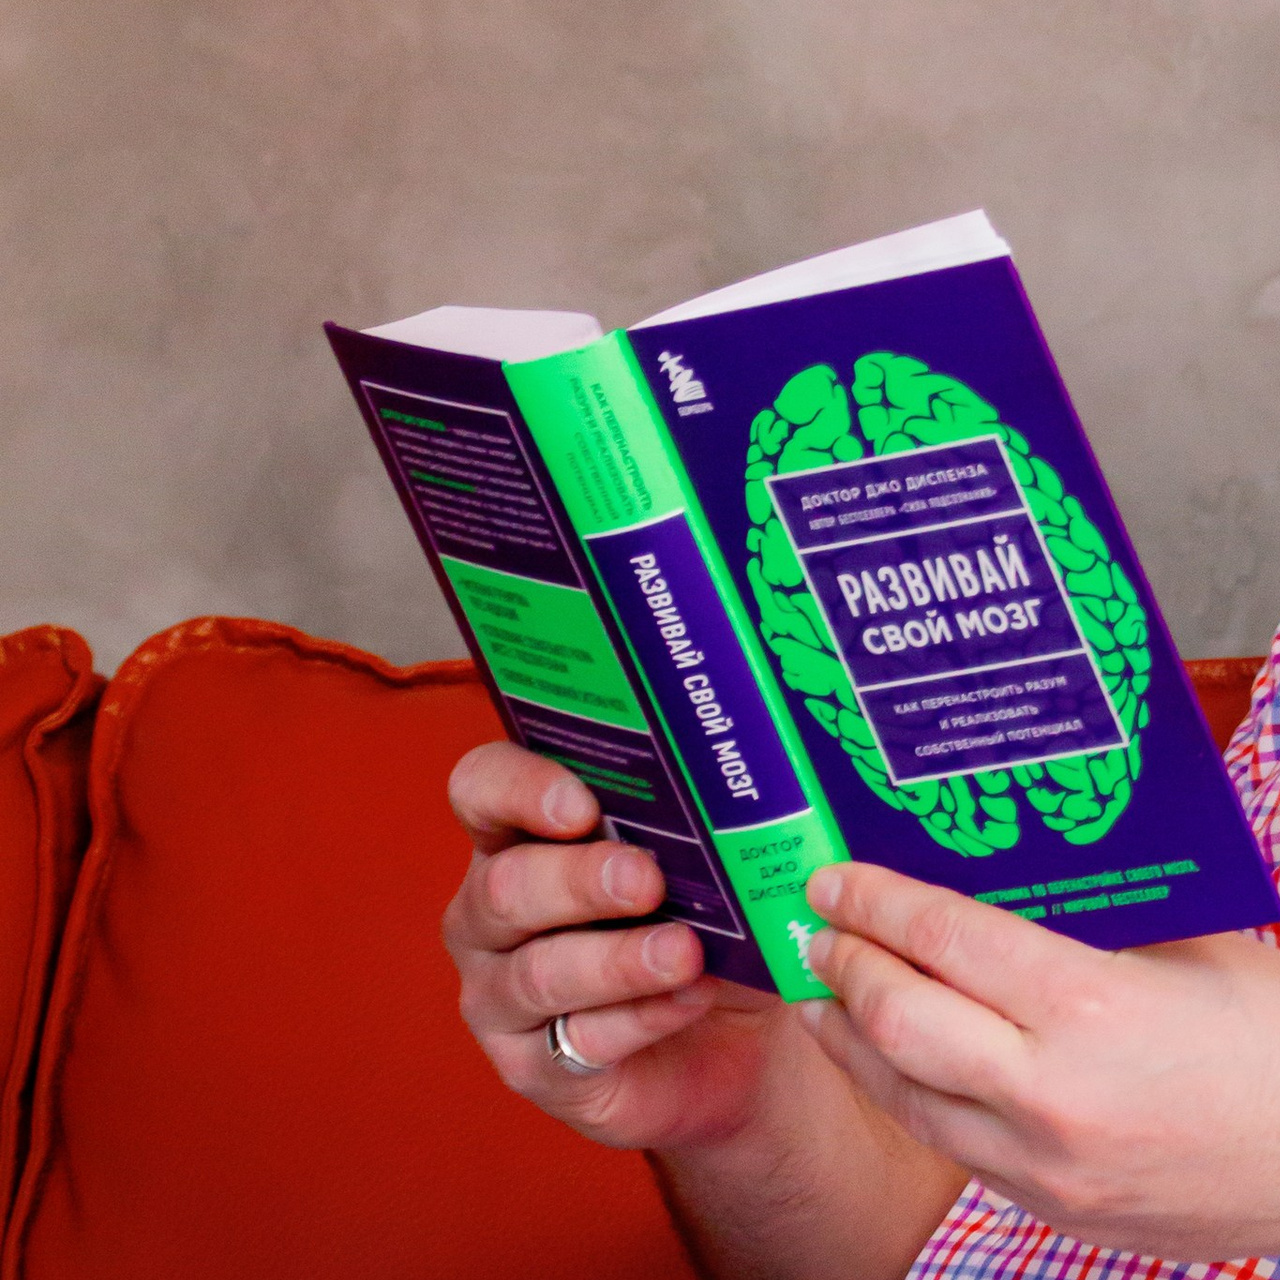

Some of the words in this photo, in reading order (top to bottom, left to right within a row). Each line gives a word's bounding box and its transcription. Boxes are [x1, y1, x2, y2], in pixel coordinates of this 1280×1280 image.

[589, 382, 609, 414] КАК
[801, 486, 861, 511] ДОКТОР
[865, 479, 901, 500] ДЖО
[905, 463, 989, 492] ДИСПЕНЗА
[836, 534, 1030, 618] РАЗВИВАЙ
[862, 609, 953, 655] СВОЙ
[955, 598, 1041, 640] МОЗГ
[629, 553, 706, 670] РАЗВИВАЙ
[682, 673, 734, 736] СВОЙ
[711, 740, 759, 801] МОЗГ
[893, 701, 920, 715] КАК
[921, 683, 1024, 711] ПЕРЕНАСТРОИТЬ
[1025, 675, 1067, 692] РАЗУМ
[939, 719, 950, 731] И
[950, 704, 1040, 728] РЕАЛИЗОВАТЬ
[914, 730, 1006, 758] СОБСТВЕННЫЙ
[1006, 719, 1083, 742] ПОТЕНЦИАЛ
[739, 836, 805, 862] ДОКТОР
[759, 860, 798, 880] ДЖО
[748, 880, 807, 902] ДИСПЕН
